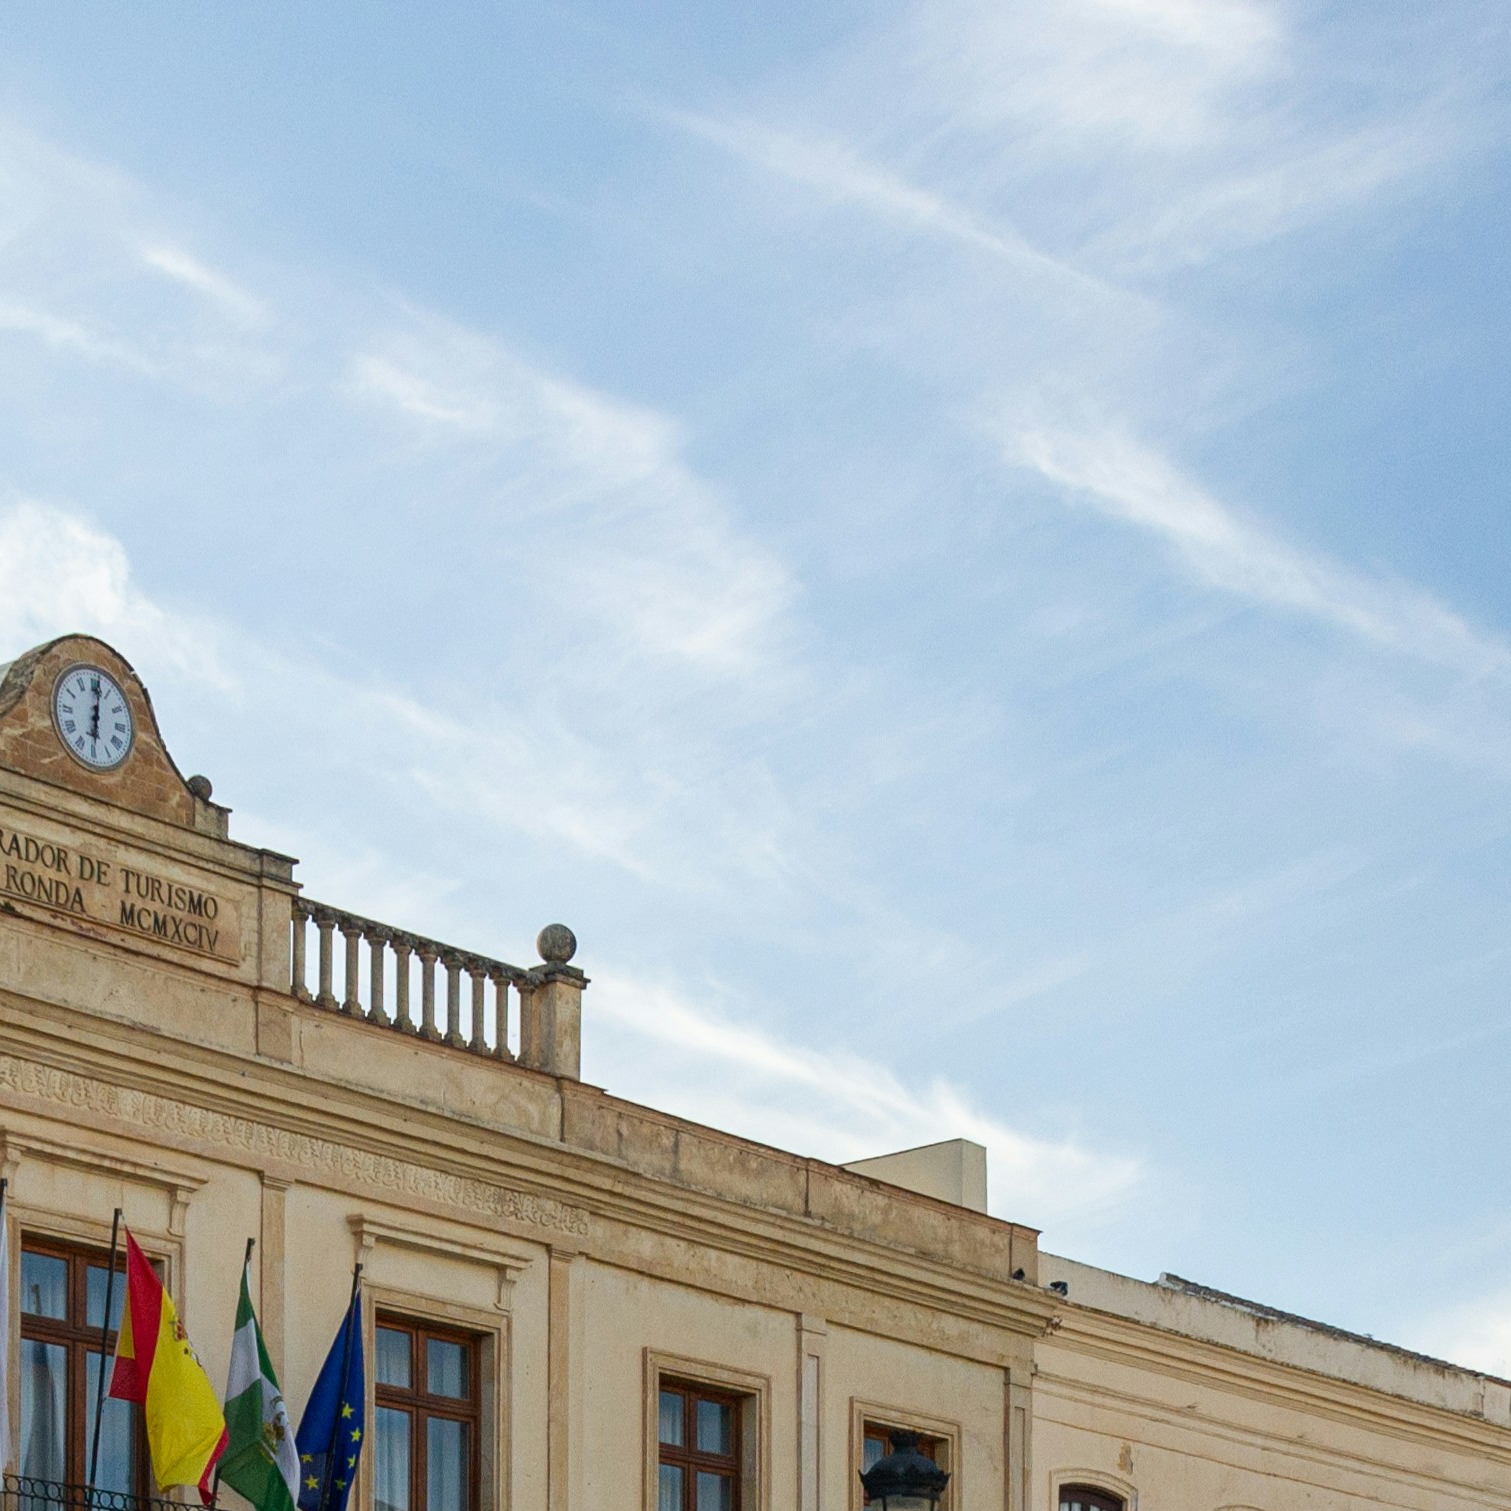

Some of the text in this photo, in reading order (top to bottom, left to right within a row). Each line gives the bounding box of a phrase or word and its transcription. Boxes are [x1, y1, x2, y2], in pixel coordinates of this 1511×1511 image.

[5, 863, 87, 914] RONDA
[120, 900, 219, 952] MCMXCIV
[79, 855, 111, 887] DE
[120, 868, 218, 921] TURISMO
